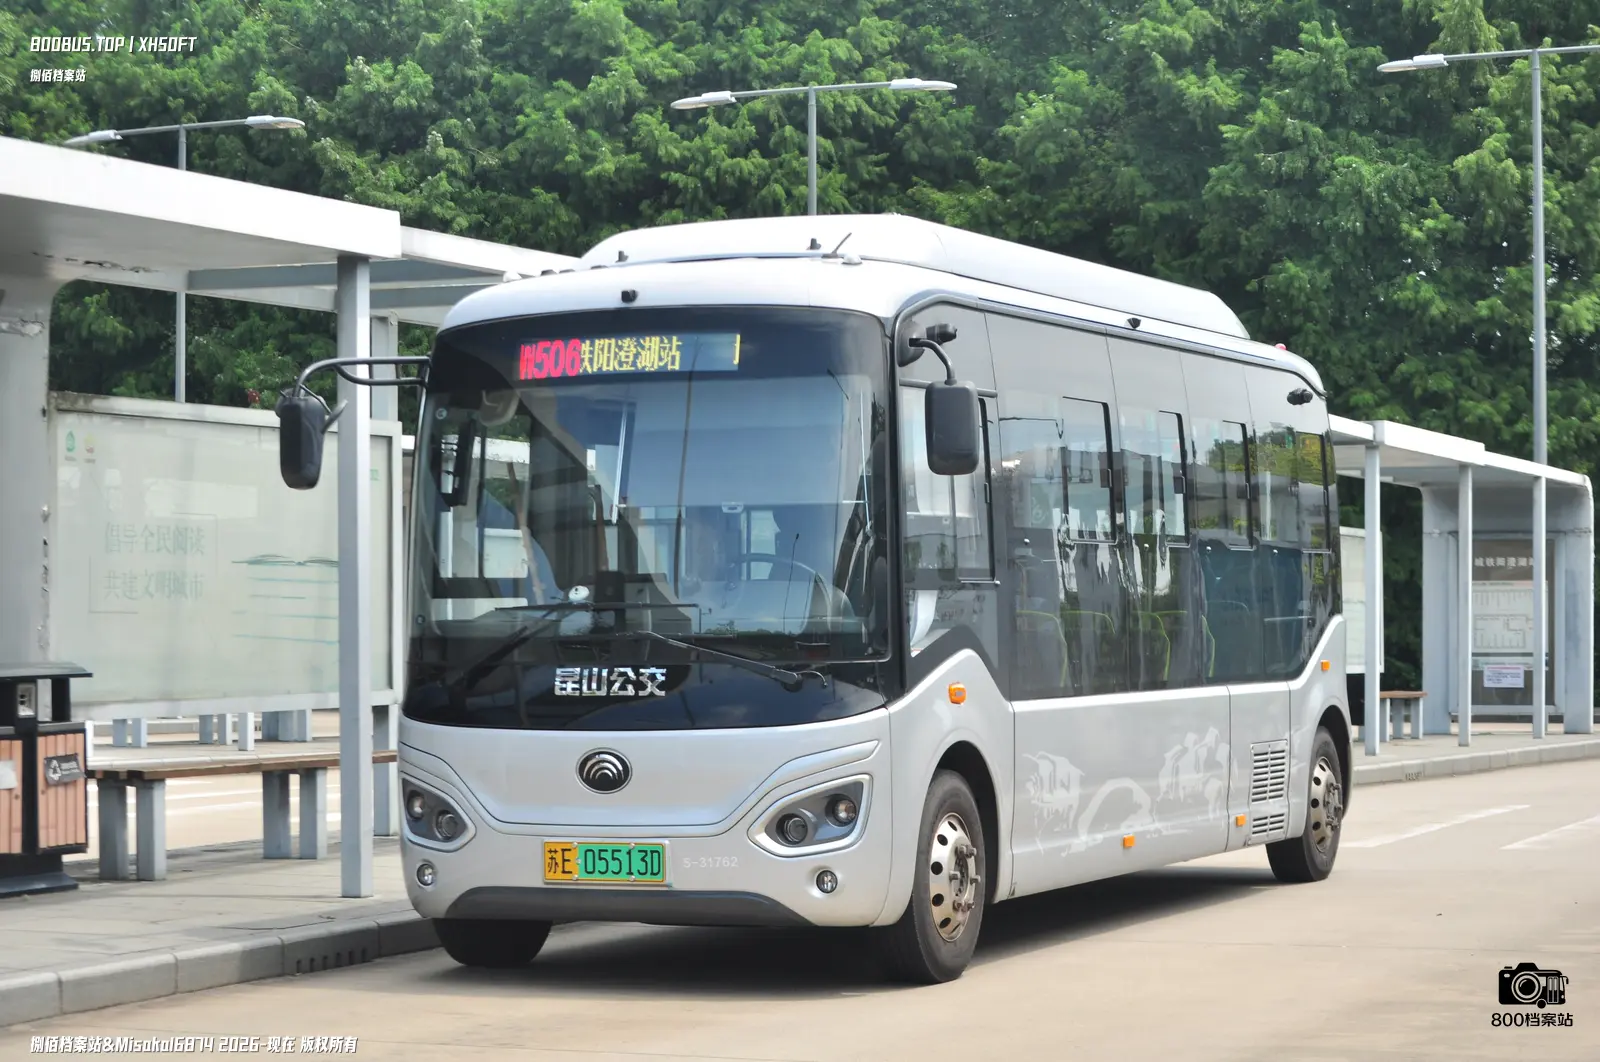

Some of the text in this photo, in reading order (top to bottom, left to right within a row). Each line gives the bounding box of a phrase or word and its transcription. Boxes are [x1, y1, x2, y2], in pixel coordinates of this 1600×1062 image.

[104, 521, 206, 555] 倡导全民阅读
[103, 568, 206, 600] 共建文明城市
[554, 667, 667, 697] 昆山公交
[547, 847, 661, 876] 苏E 05513D
[682, 856, 739, 869] S-31762
